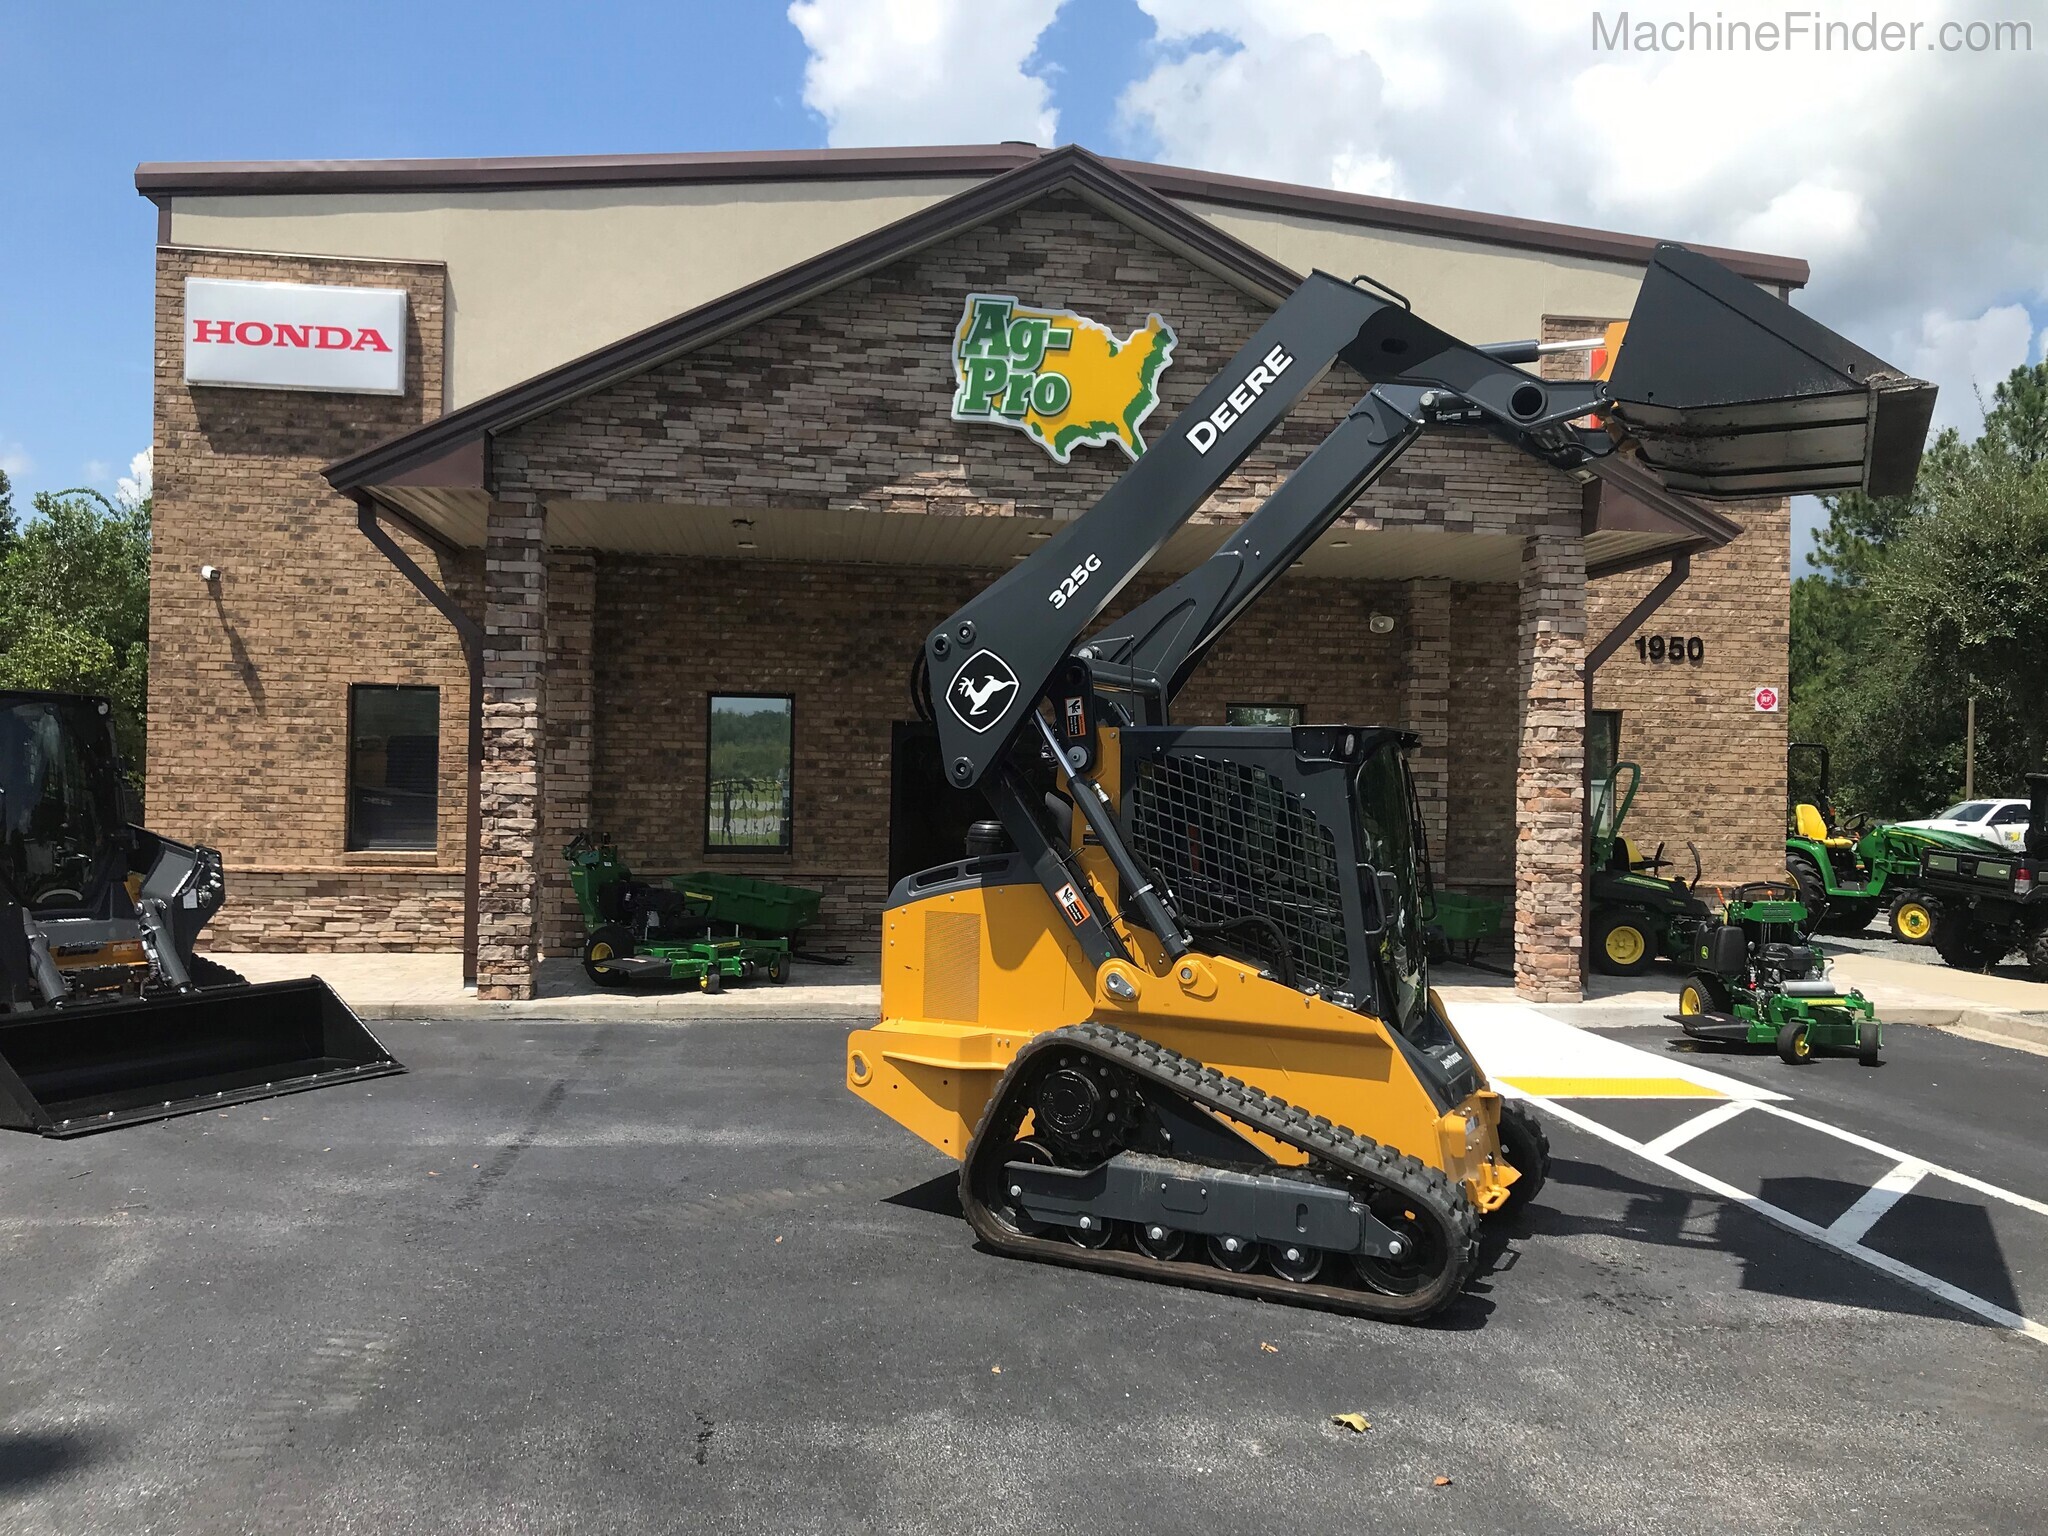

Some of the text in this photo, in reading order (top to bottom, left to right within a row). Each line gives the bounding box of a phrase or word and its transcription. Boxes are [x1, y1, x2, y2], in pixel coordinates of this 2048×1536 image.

[193, 319, 393, 353] HONDA
[960, 299, 1073, 372] Ag-
[958, 357, 1071, 416] Pro
[1185, 344, 1294, 455] DEERE
[1048, 553, 1102, 610] 325G
[1635, 635, 1704, 661] 1950
